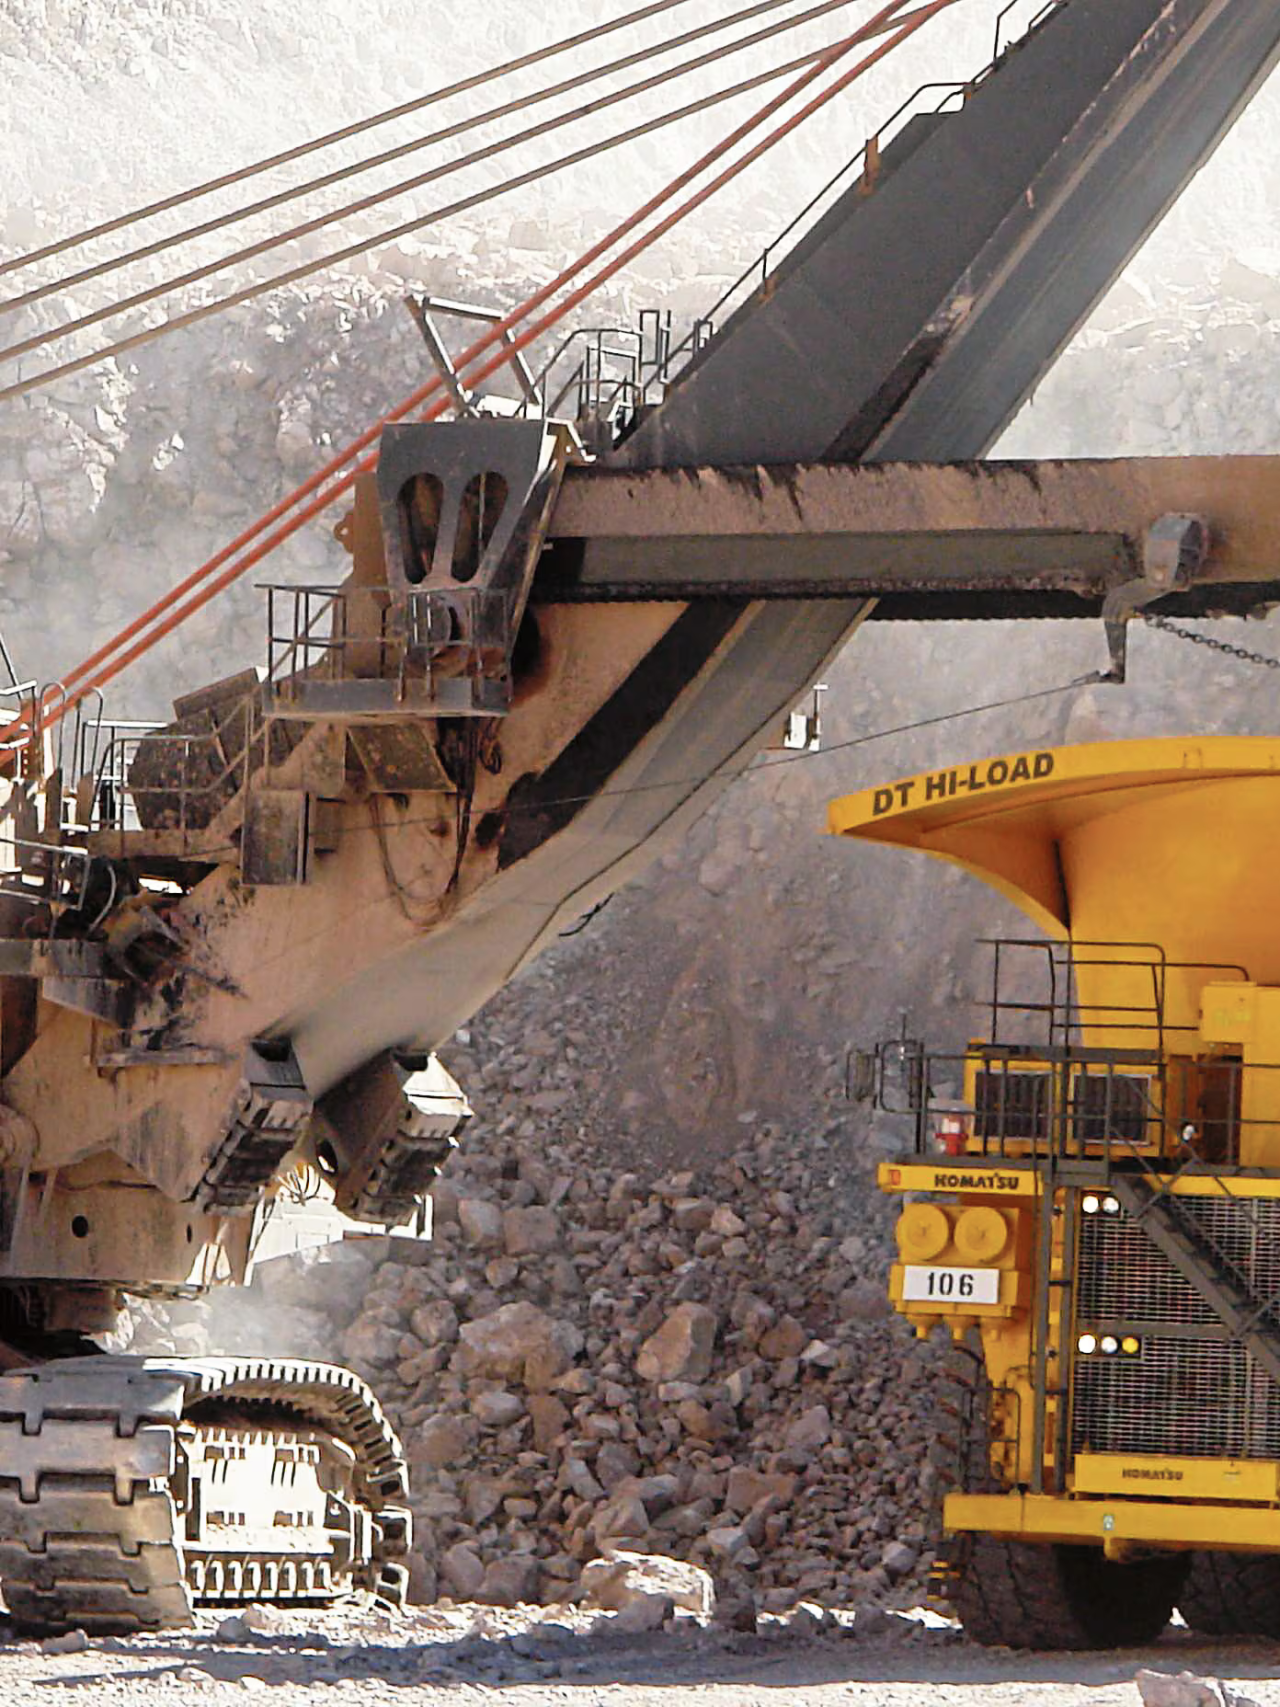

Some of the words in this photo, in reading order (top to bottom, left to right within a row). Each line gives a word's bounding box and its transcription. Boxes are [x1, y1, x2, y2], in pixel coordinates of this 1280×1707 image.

[872, 780, 915, 816] DT
[924, 752, 1055, 801] HI-LOAD
[934, 1173, 1020, 1189] KOMATSU
[927, 1271, 974, 1296] 106
[1122, 1467, 1184, 1481] KOMATSU
